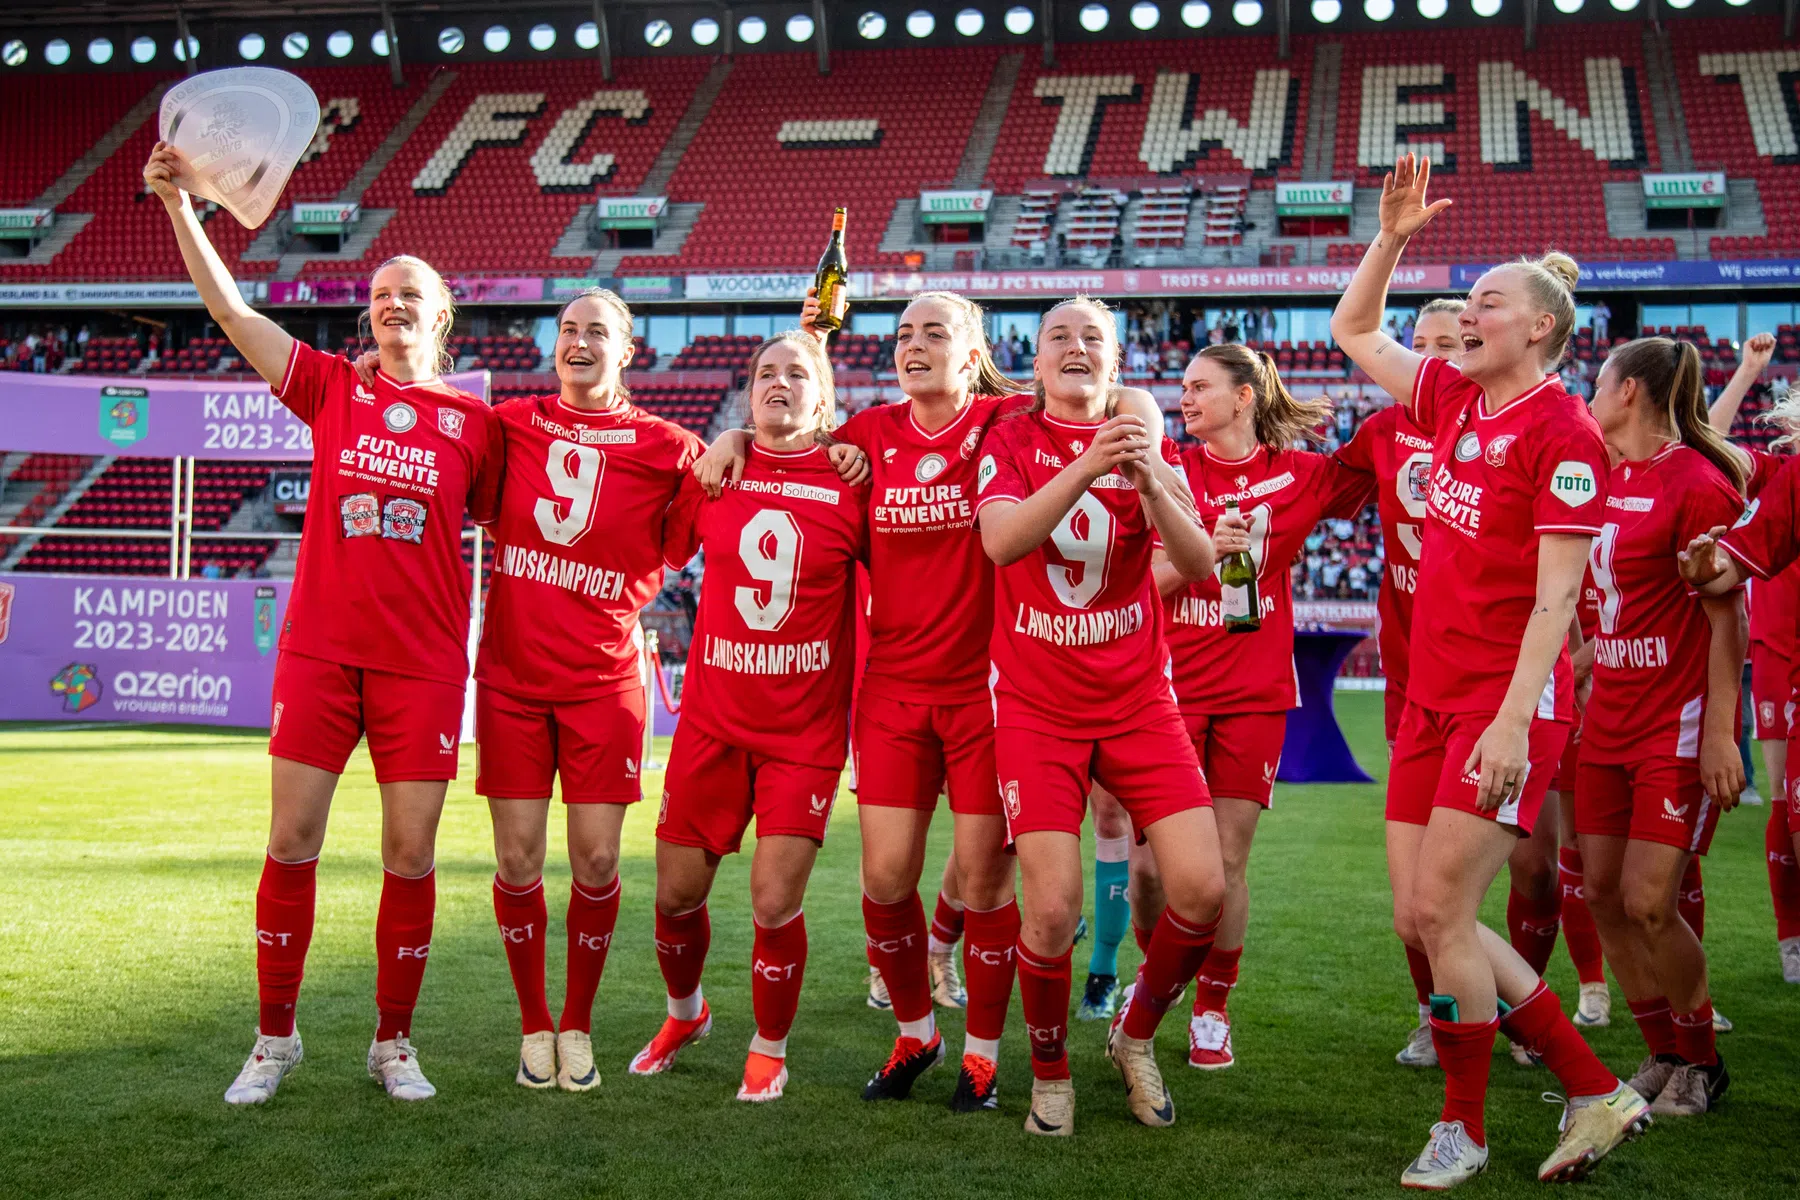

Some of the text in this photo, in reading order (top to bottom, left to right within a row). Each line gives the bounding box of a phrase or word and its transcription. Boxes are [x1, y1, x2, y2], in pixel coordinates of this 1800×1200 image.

[411, 88, 648, 192] FC
[1160, 273, 1209, 288] TROTS
[1226, 272, 1290, 287] AMBITIE
[1718, 264, 1742, 280] Wij
[203, 422, 313, 450] 2023-20
[581, 431, 634, 443] Solutions
[1395, 431, 1434, 451] THERM
[356, 434, 437, 468] FUTURE
[340, 449, 440, 487] OF TWENTE
[338, 468, 356, 478] meer
[390, 479, 410, 491] meer
[1091, 475, 1133, 490] olutions
[1555, 474, 1591, 492] TOTO
[533, 440, 607, 547] 9
[784, 484, 837, 503] Solutions
[884, 484, 963, 505] FUTURE
[875, 499, 972, 525] OF TWENTE
[925, 524, 946, 533] meer
[1046, 490, 1116, 610] 9
[734, 509, 804, 632] 9
[73, 587, 228, 619] KAMPIOEN
[1015, 602, 1143, 646] LANDSKAMPIOEN
[73, 620, 228, 652] 2023-2024
[703, 633, 830, 675] LANDSKAMPIOEN
[113, 667, 232, 701] azerion
[113, 699, 177, 714] vrouwen
[1563, 884, 1584, 899] FC
[255, 929, 292, 946] CT
[500, 923, 534, 943] FCT
[578, 932, 612, 950] FCT
[866, 933, 916, 953] FCT
[397, 944, 430, 960] FC
[655, 938, 687, 955] CT
[969, 944, 1014, 966] FCT
[754, 959, 796, 982] FCT
[1026, 1024, 1061, 1042] FCT
